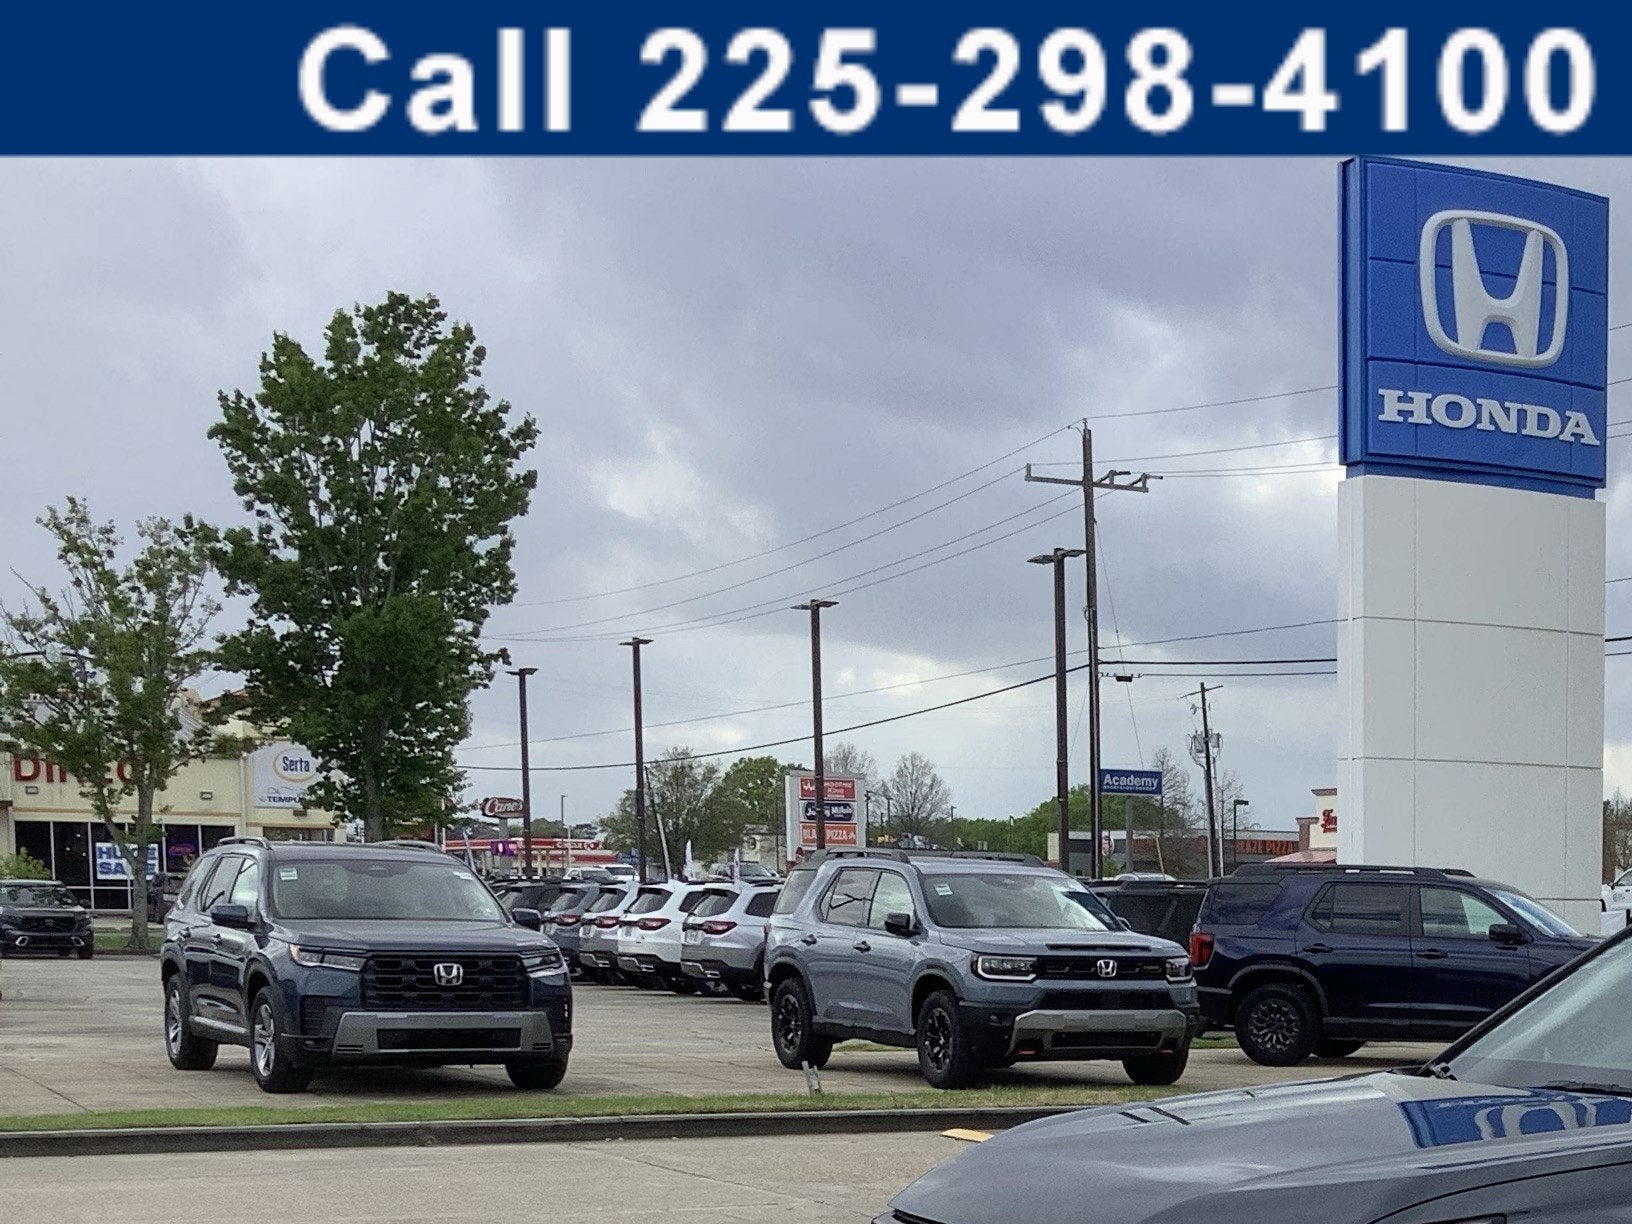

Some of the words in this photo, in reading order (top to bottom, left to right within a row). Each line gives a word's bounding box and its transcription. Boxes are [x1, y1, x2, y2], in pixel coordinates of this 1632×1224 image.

[1378, 388, 1600, 446] HONDA
[282, 756, 310, 772] Serta
[1103, 773, 1159, 790] Academy
